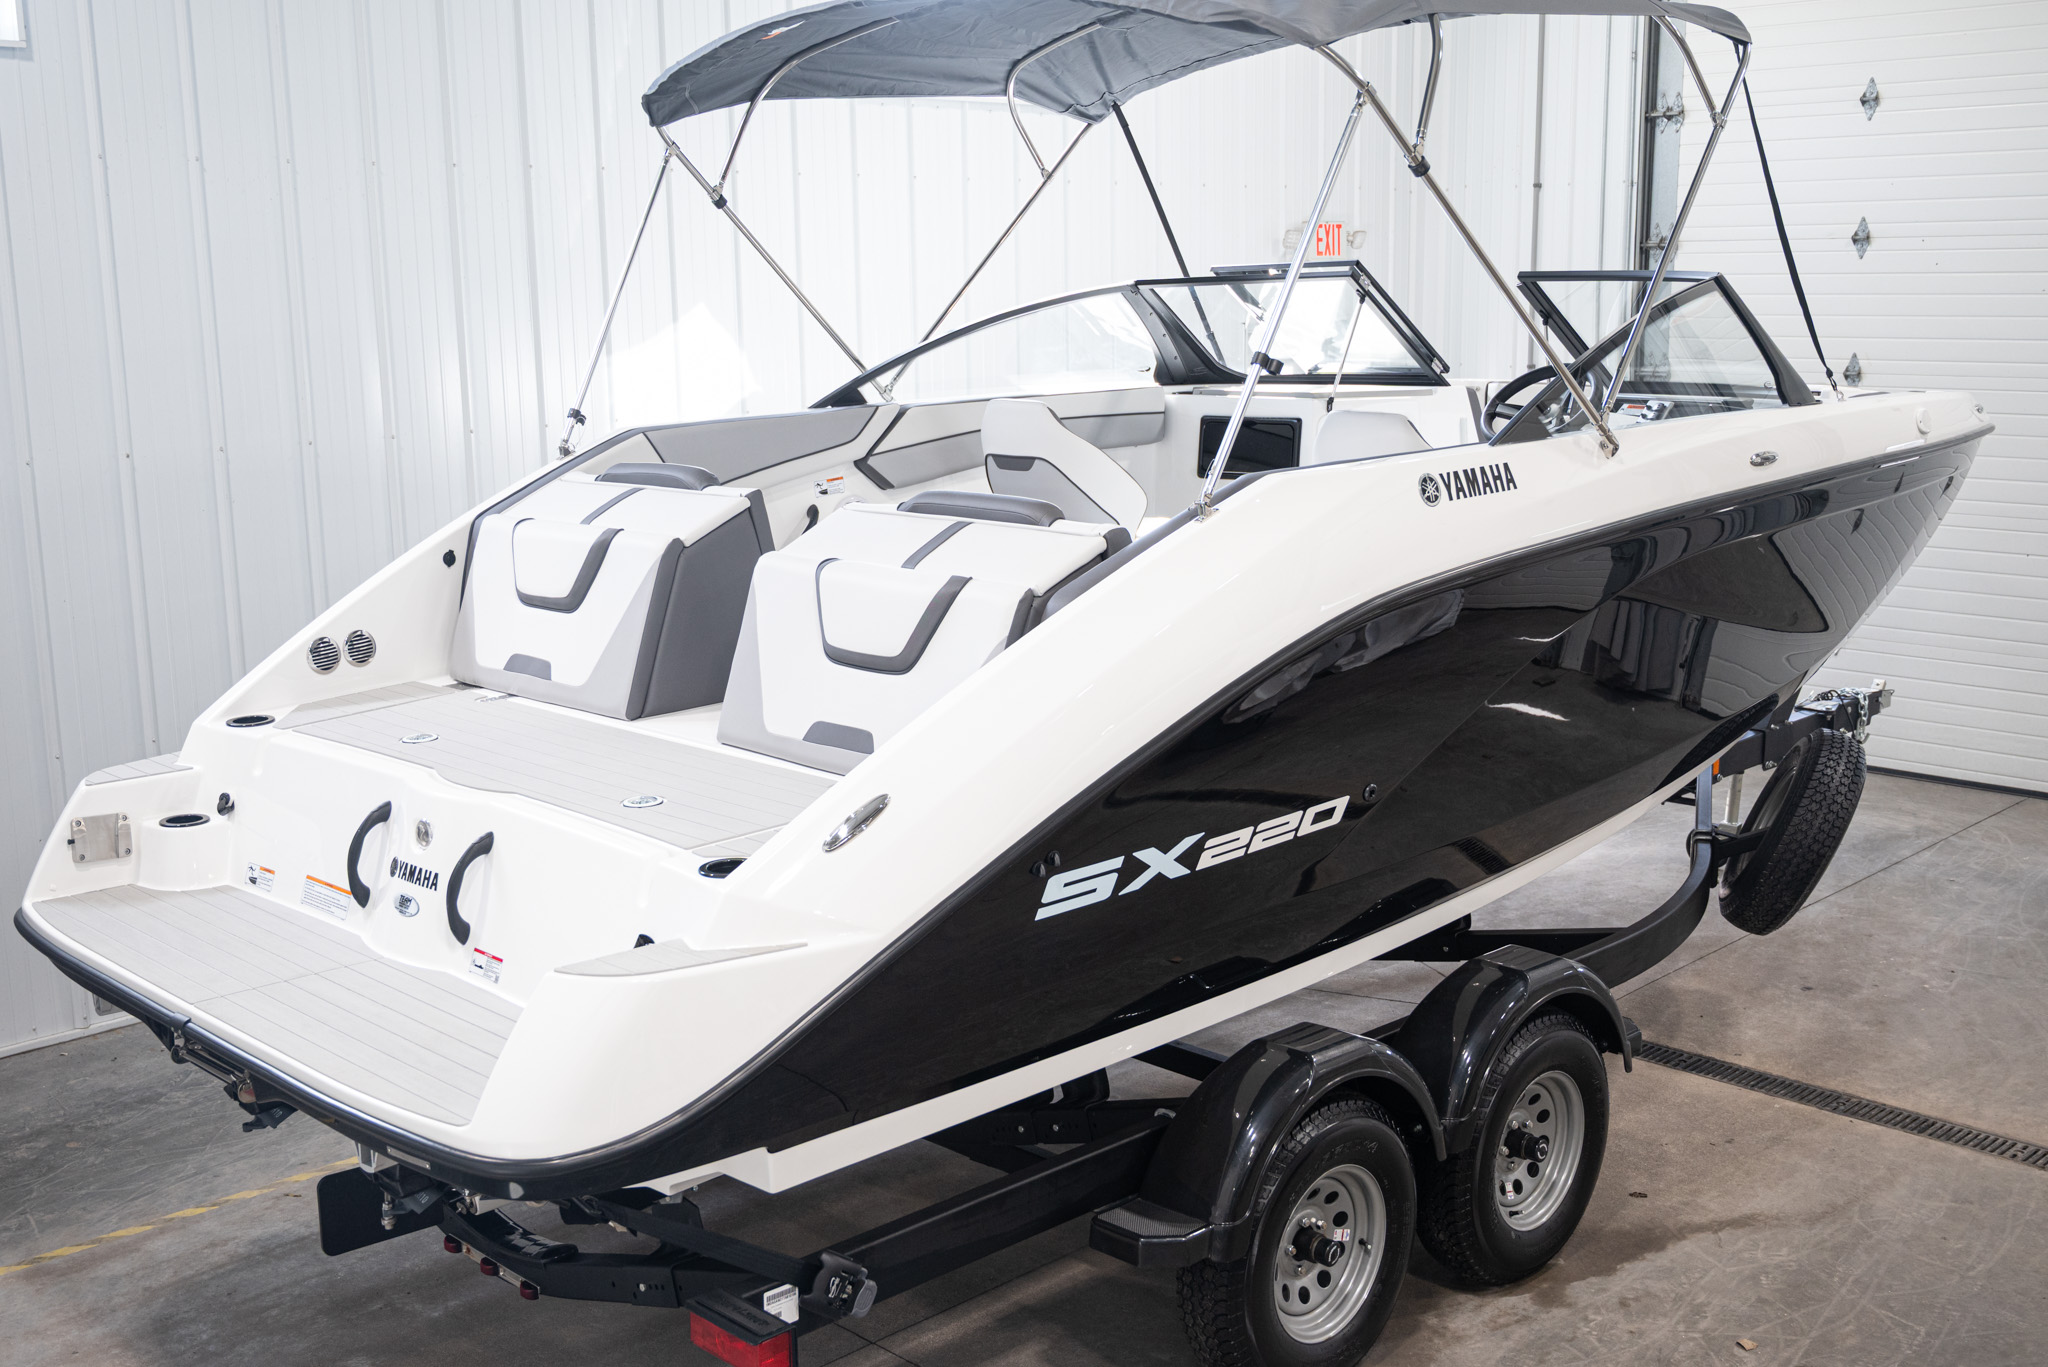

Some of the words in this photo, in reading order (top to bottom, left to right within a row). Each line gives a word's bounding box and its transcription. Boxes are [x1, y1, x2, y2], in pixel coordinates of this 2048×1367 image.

[1316, 224, 1342, 256] EXIT
[1439, 462, 1517, 501] YAMAHA
[397, 860, 439, 891] YAMAHA
[1034, 795, 1349, 922] SX220
